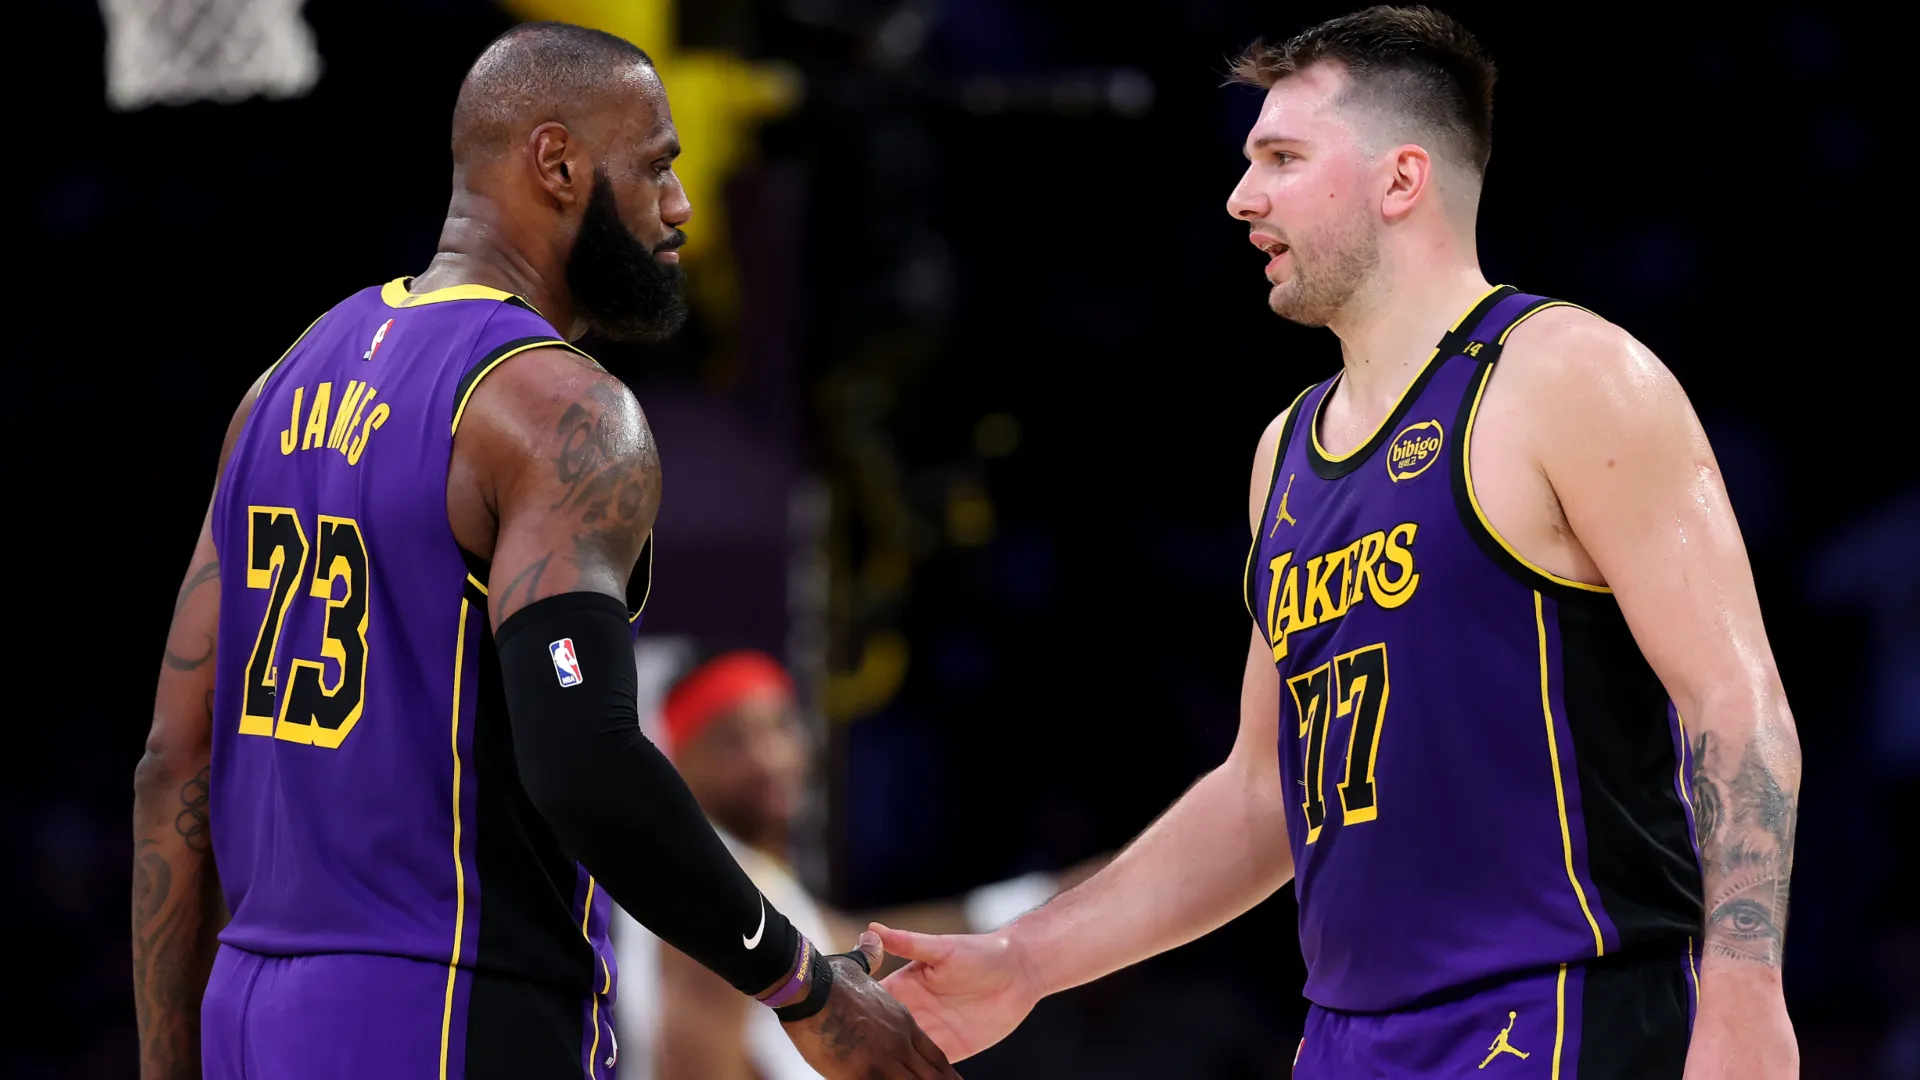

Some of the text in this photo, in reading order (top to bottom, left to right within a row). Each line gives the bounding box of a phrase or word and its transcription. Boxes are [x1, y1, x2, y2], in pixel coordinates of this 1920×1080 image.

[280, 380, 391, 466] JAMES
[1392, 436, 1439, 462] bibigo
[238, 505, 370, 749] 23
[1267, 522, 1419, 664] LAKERS
[1286, 642, 1390, 845] 77
